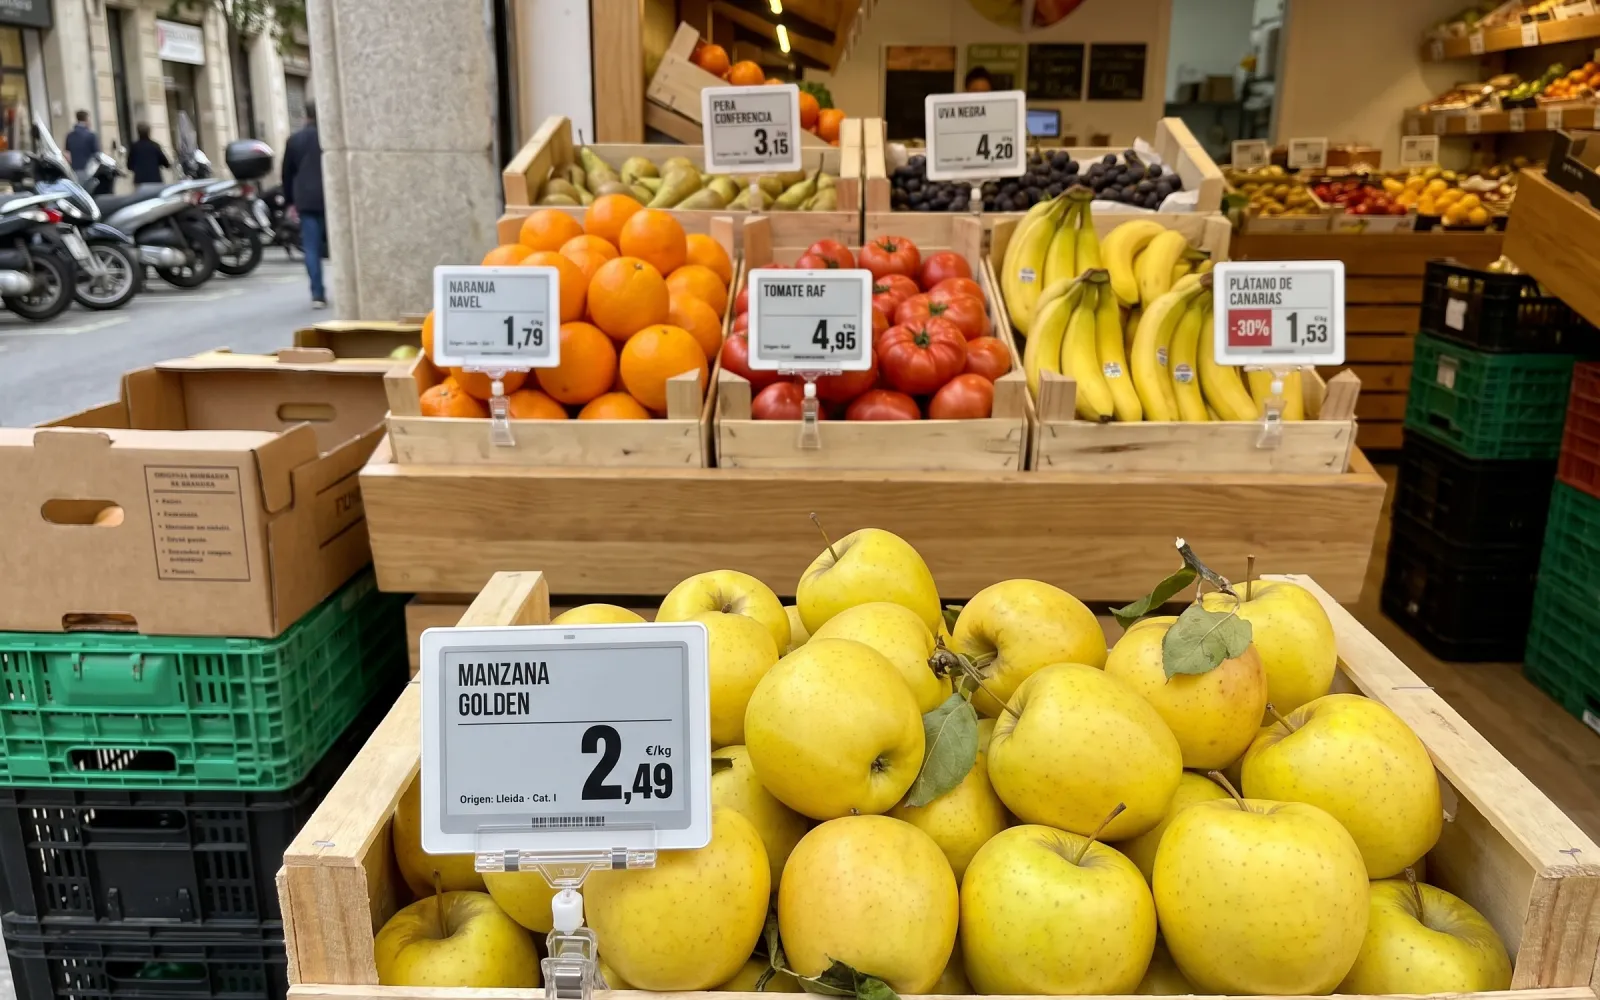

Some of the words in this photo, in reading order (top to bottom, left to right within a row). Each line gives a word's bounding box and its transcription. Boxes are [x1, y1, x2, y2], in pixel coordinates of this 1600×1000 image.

[714, 100, 736, 111] PERA
[958, 106, 985, 117] NEGRA
[715, 112, 772, 124] CONFERENCIA
[754, 129, 788, 157] 3,15
[976, 134, 1012, 161] 4,20
[450, 281, 495, 293] NARANJA
[1230, 275, 1276, 290] PLÁTANO
[1280, 277, 1292, 290] DE
[764, 285, 803, 297] TOMATE
[807, 285, 825, 297] RAF
[1230, 292, 1281, 305] CANARIAS
[450, 296, 481, 308] NAVEL
[504, 316, 543, 349] 1,79
[1231, 319, 1270, 336] -30%
[1287, 312, 1327, 346] 1,53
[812, 320, 856, 352] 4,95
[459, 662, 549, 686] MANZANA
[459, 692, 529, 716] GOLDEN
[646, 745, 671, 757] €/kg
[582, 725, 673, 804] 2,49
[460, 795, 493, 805] Origen:
[497, 794, 524, 803] Lleida
[533, 794, 550, 802] Cat.
